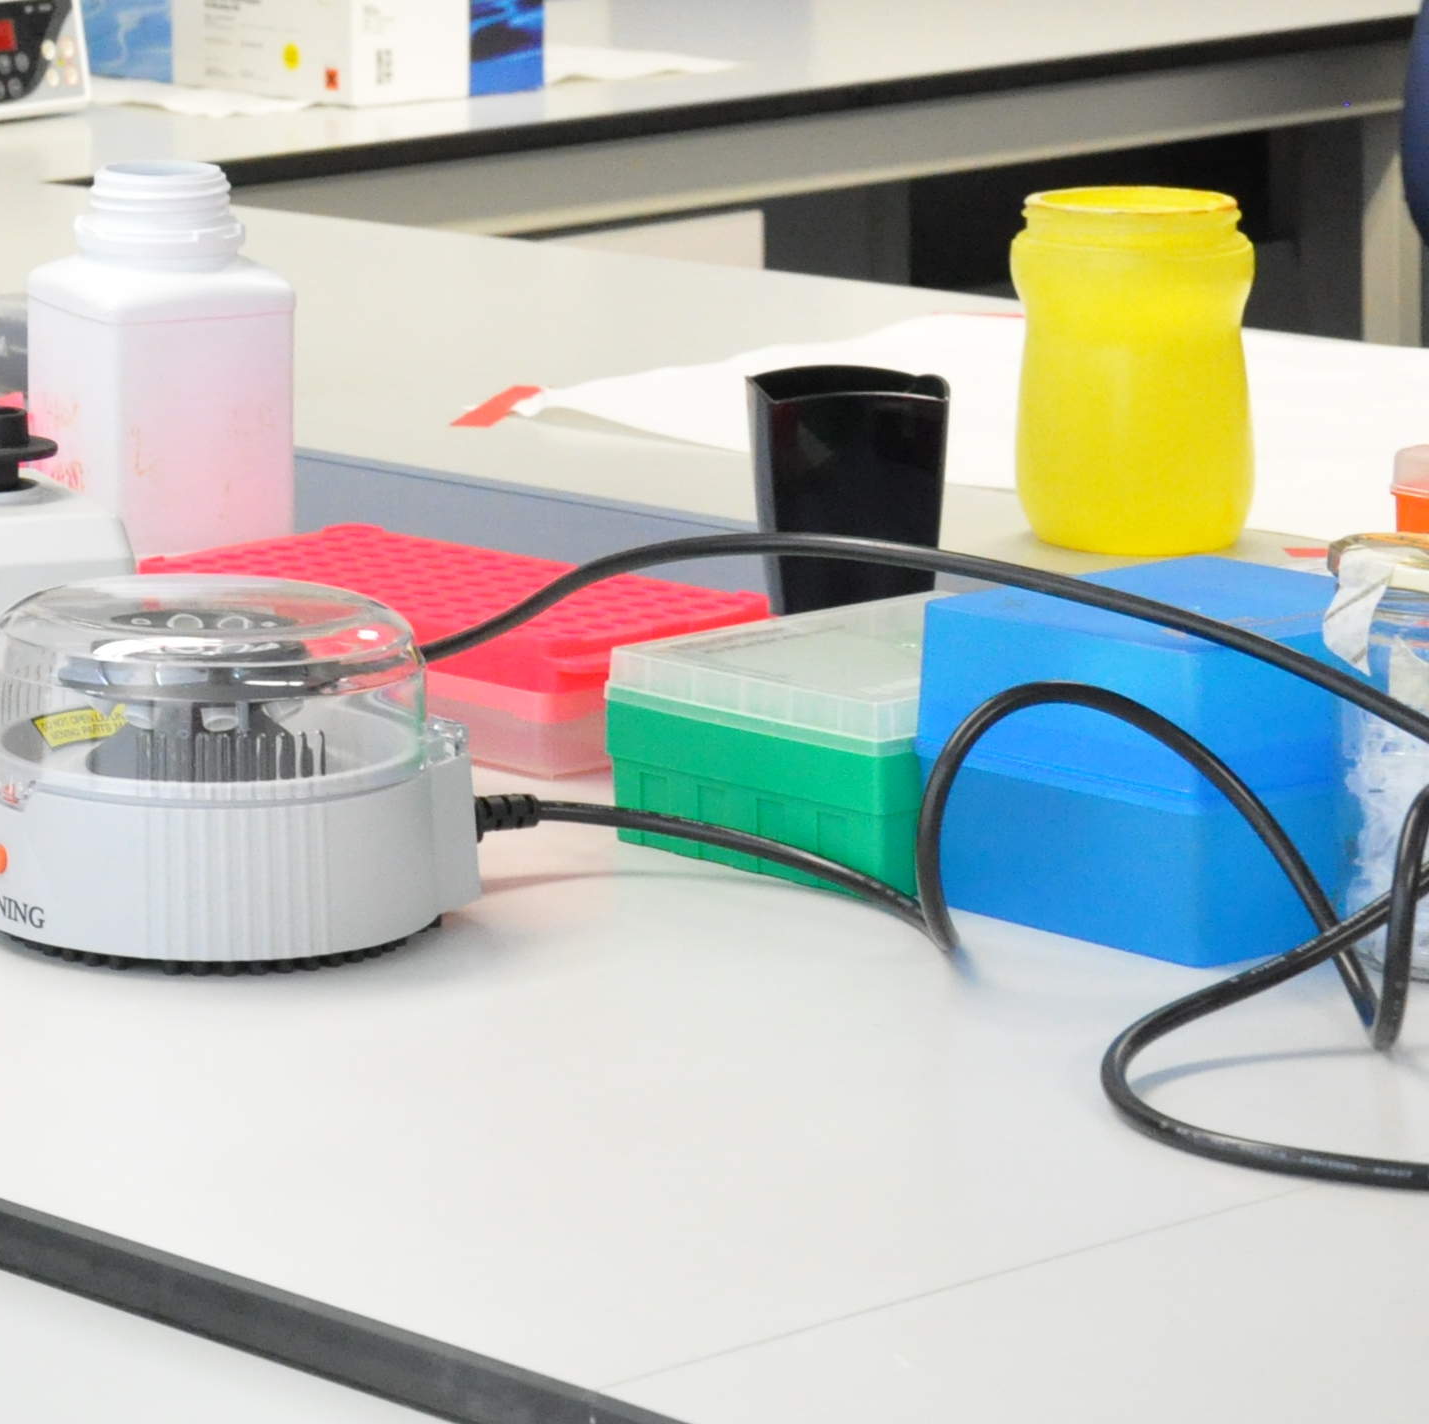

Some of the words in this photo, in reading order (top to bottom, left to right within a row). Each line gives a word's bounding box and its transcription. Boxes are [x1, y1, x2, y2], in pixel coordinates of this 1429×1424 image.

[53, 717, 69, 728] NOT
[69, 714, 94, 725] OPEN
[81, 723, 112, 735] PARTS
